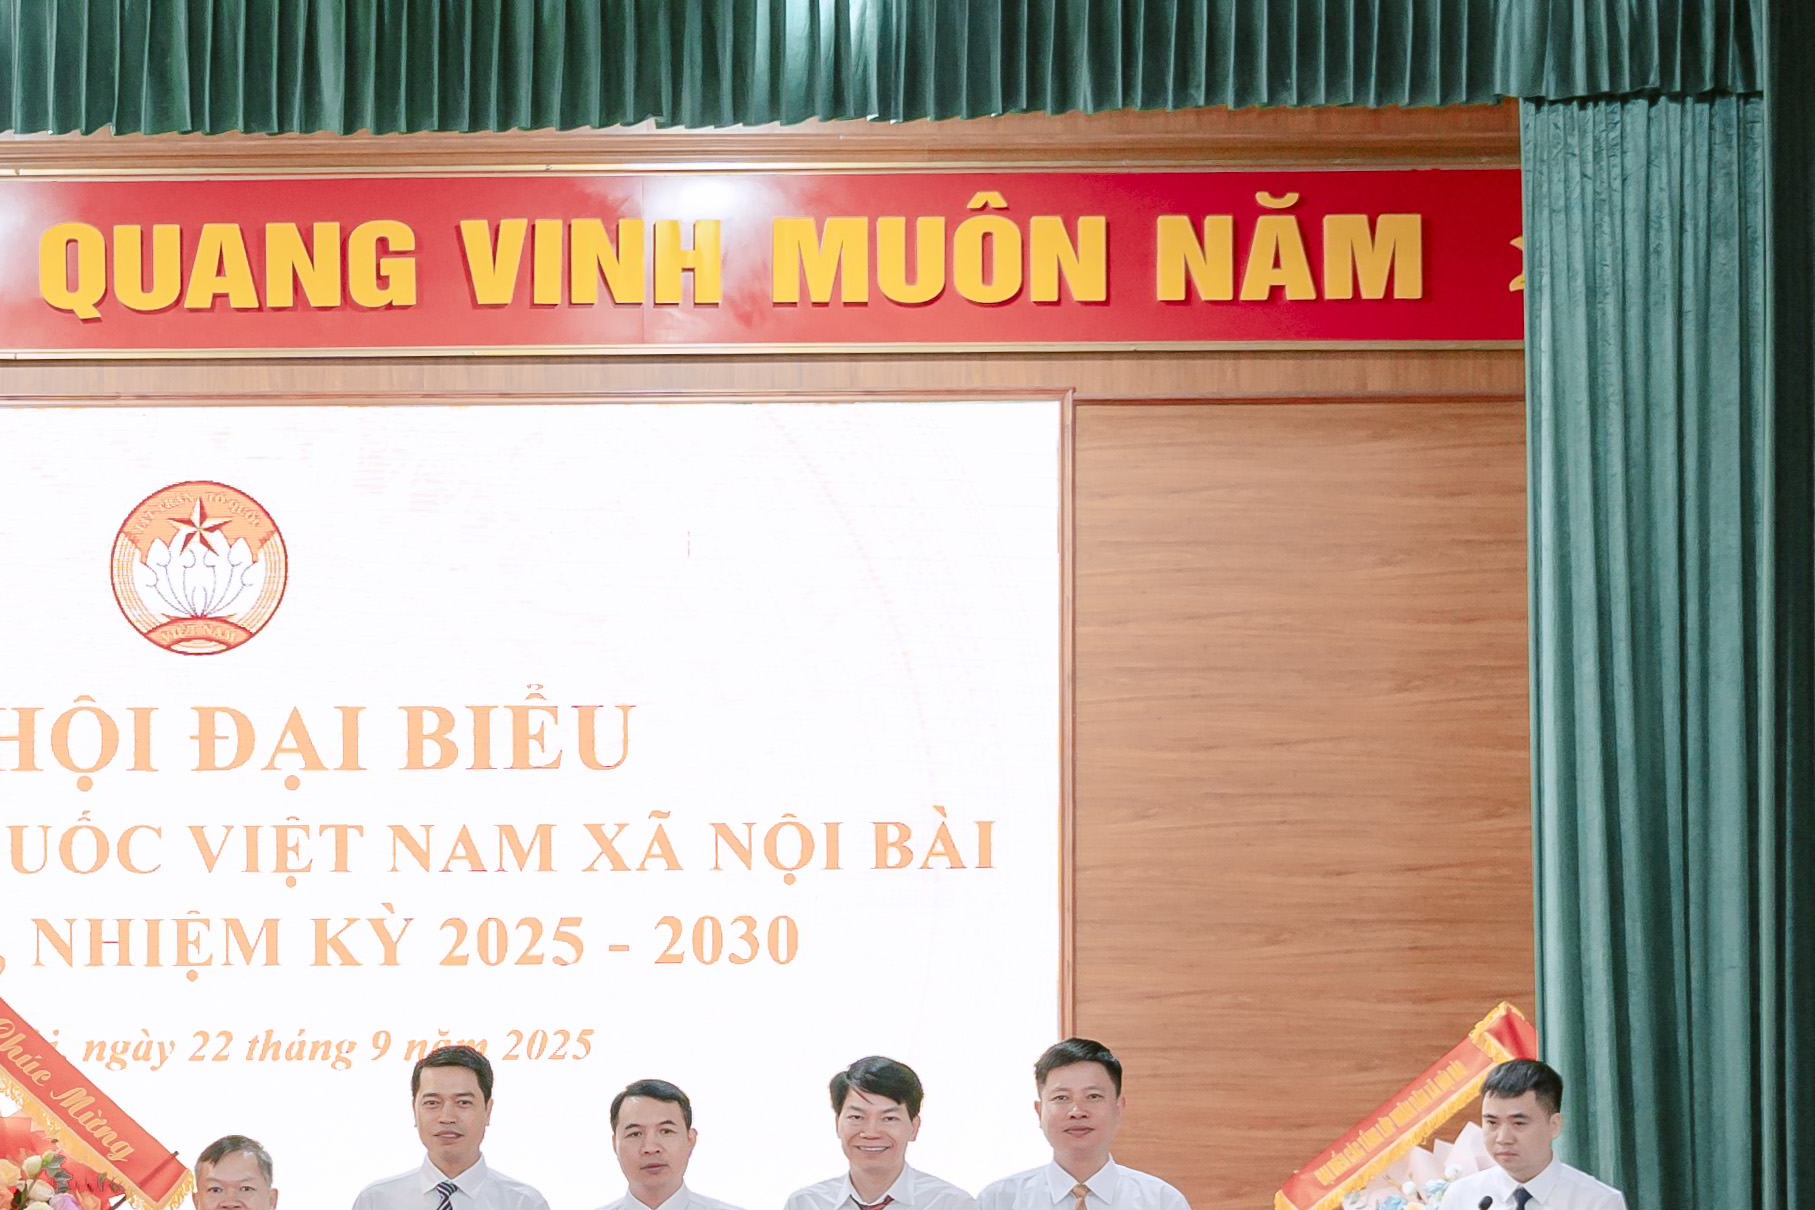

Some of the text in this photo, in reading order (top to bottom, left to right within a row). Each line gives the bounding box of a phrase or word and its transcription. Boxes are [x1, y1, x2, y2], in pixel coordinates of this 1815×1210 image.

[39, 220, 416, 319] QUANG
[460, 218, 722, 305] VINH
[772, 192, 1106, 303] MUÔN
[1157, 193, 1421, 301] NĂM
[189, 705, 368, 792] ĐẠI
[397, 684, 636, 771] BIỂU
[188, 815, 364, 889] VIỆT
[387, 823, 557, 873] NAM
[582, 809, 683, 873] XÃ
[709, 812, 841, 886] NỘI
[872, 804, 995, 870] BÀI
[31, 910, 281, 983] NHIỆM
[310, 902, 414, 967] KỲ
[439, 916, 584, 967] 2025
[654, 915, 799, 966] 2030
[82, 1028, 176, 1071] ngày
[188, 1030, 234, 1062] 22
[245, 1029, 358, 1070] tháng
[370, 1030, 392, 1061] 9
[501, 1028, 595, 1061] 2025
[50, 1087, 135, 1162] Mừng
